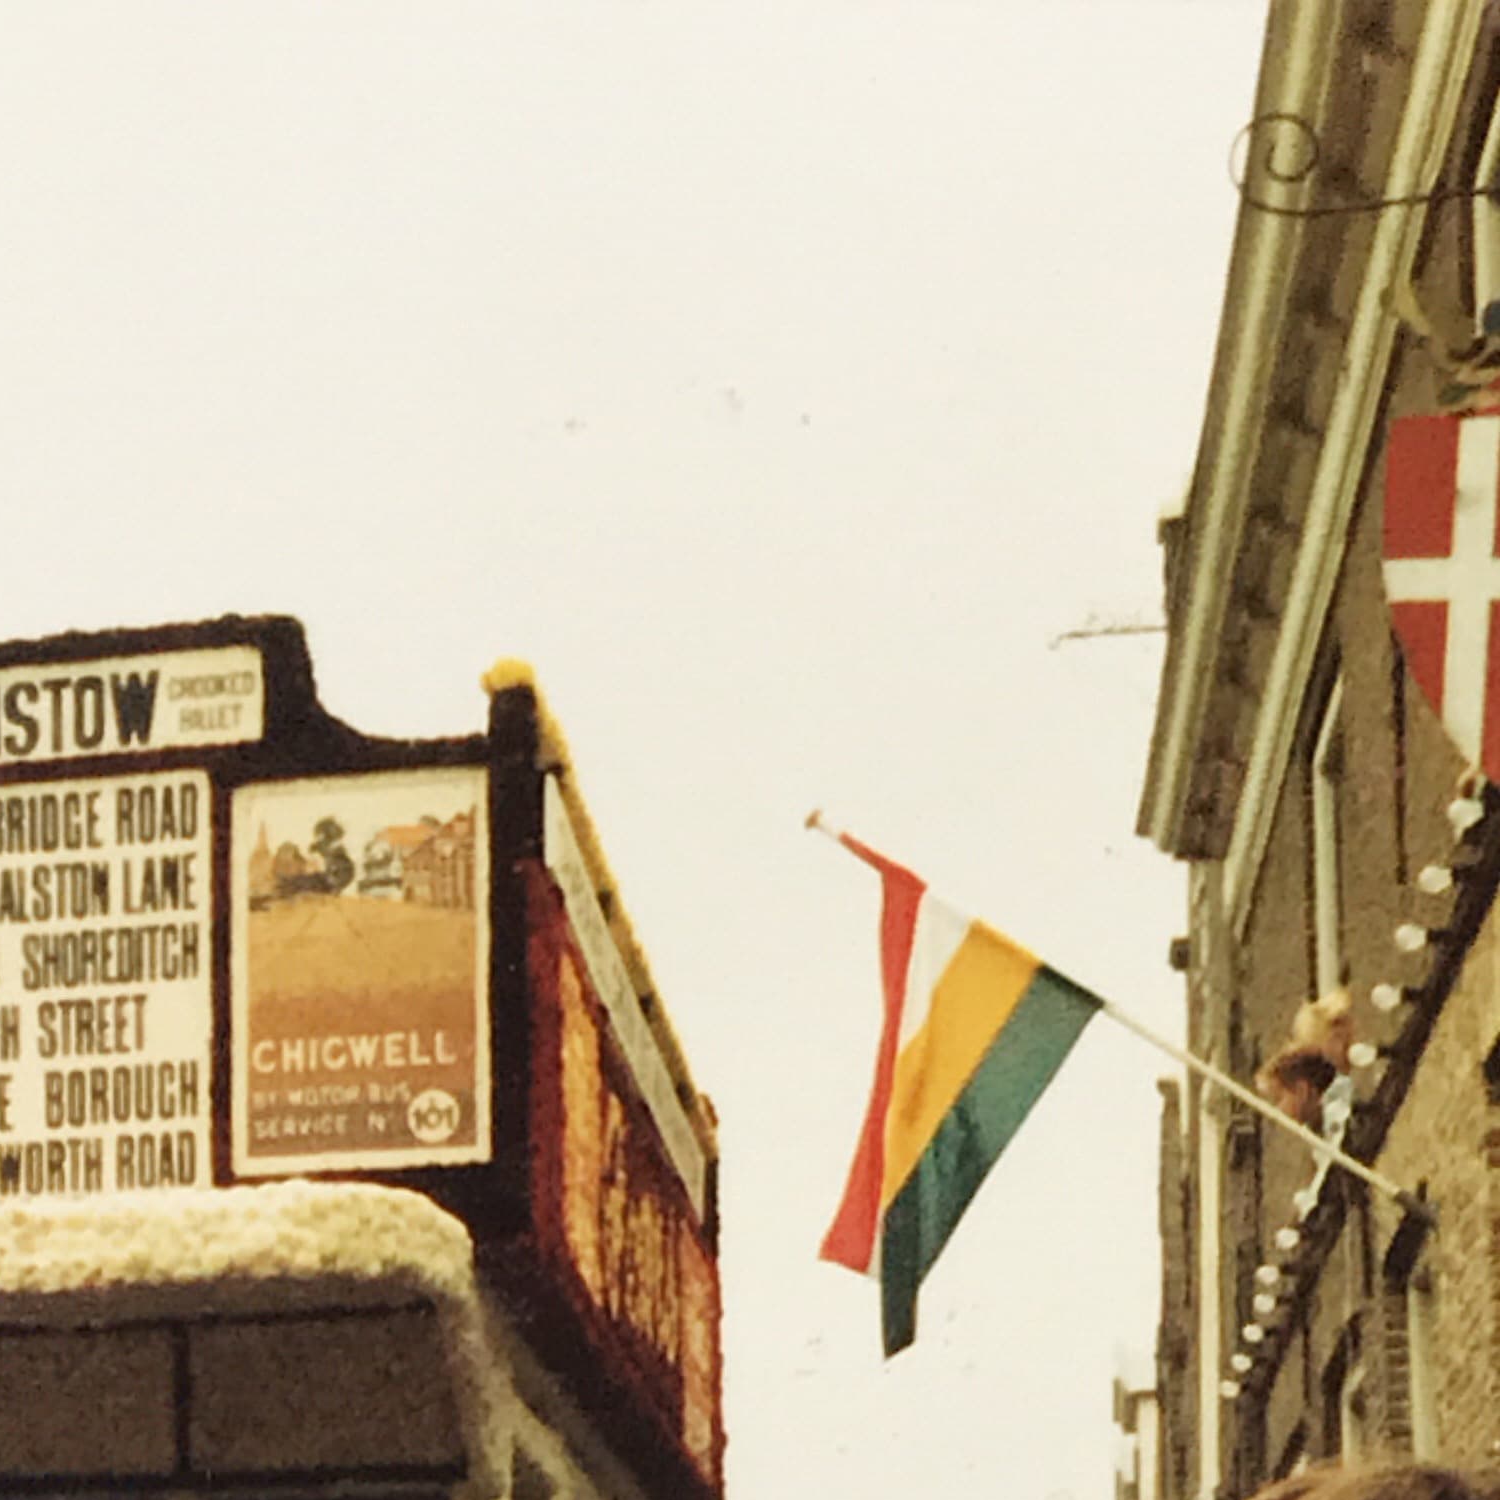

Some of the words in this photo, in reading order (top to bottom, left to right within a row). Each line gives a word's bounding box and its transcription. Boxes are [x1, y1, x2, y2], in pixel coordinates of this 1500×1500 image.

[116, 782, 197, 846] ROAD
[121, 852, 197, 916] LANE
[21, 922, 199, 992] SHOREDITCH
[36, 994, 147, 1060] STREET
[44, 1060, 199, 1130] BOROUGH
[115, 1130, 197, 1190] ROAD
